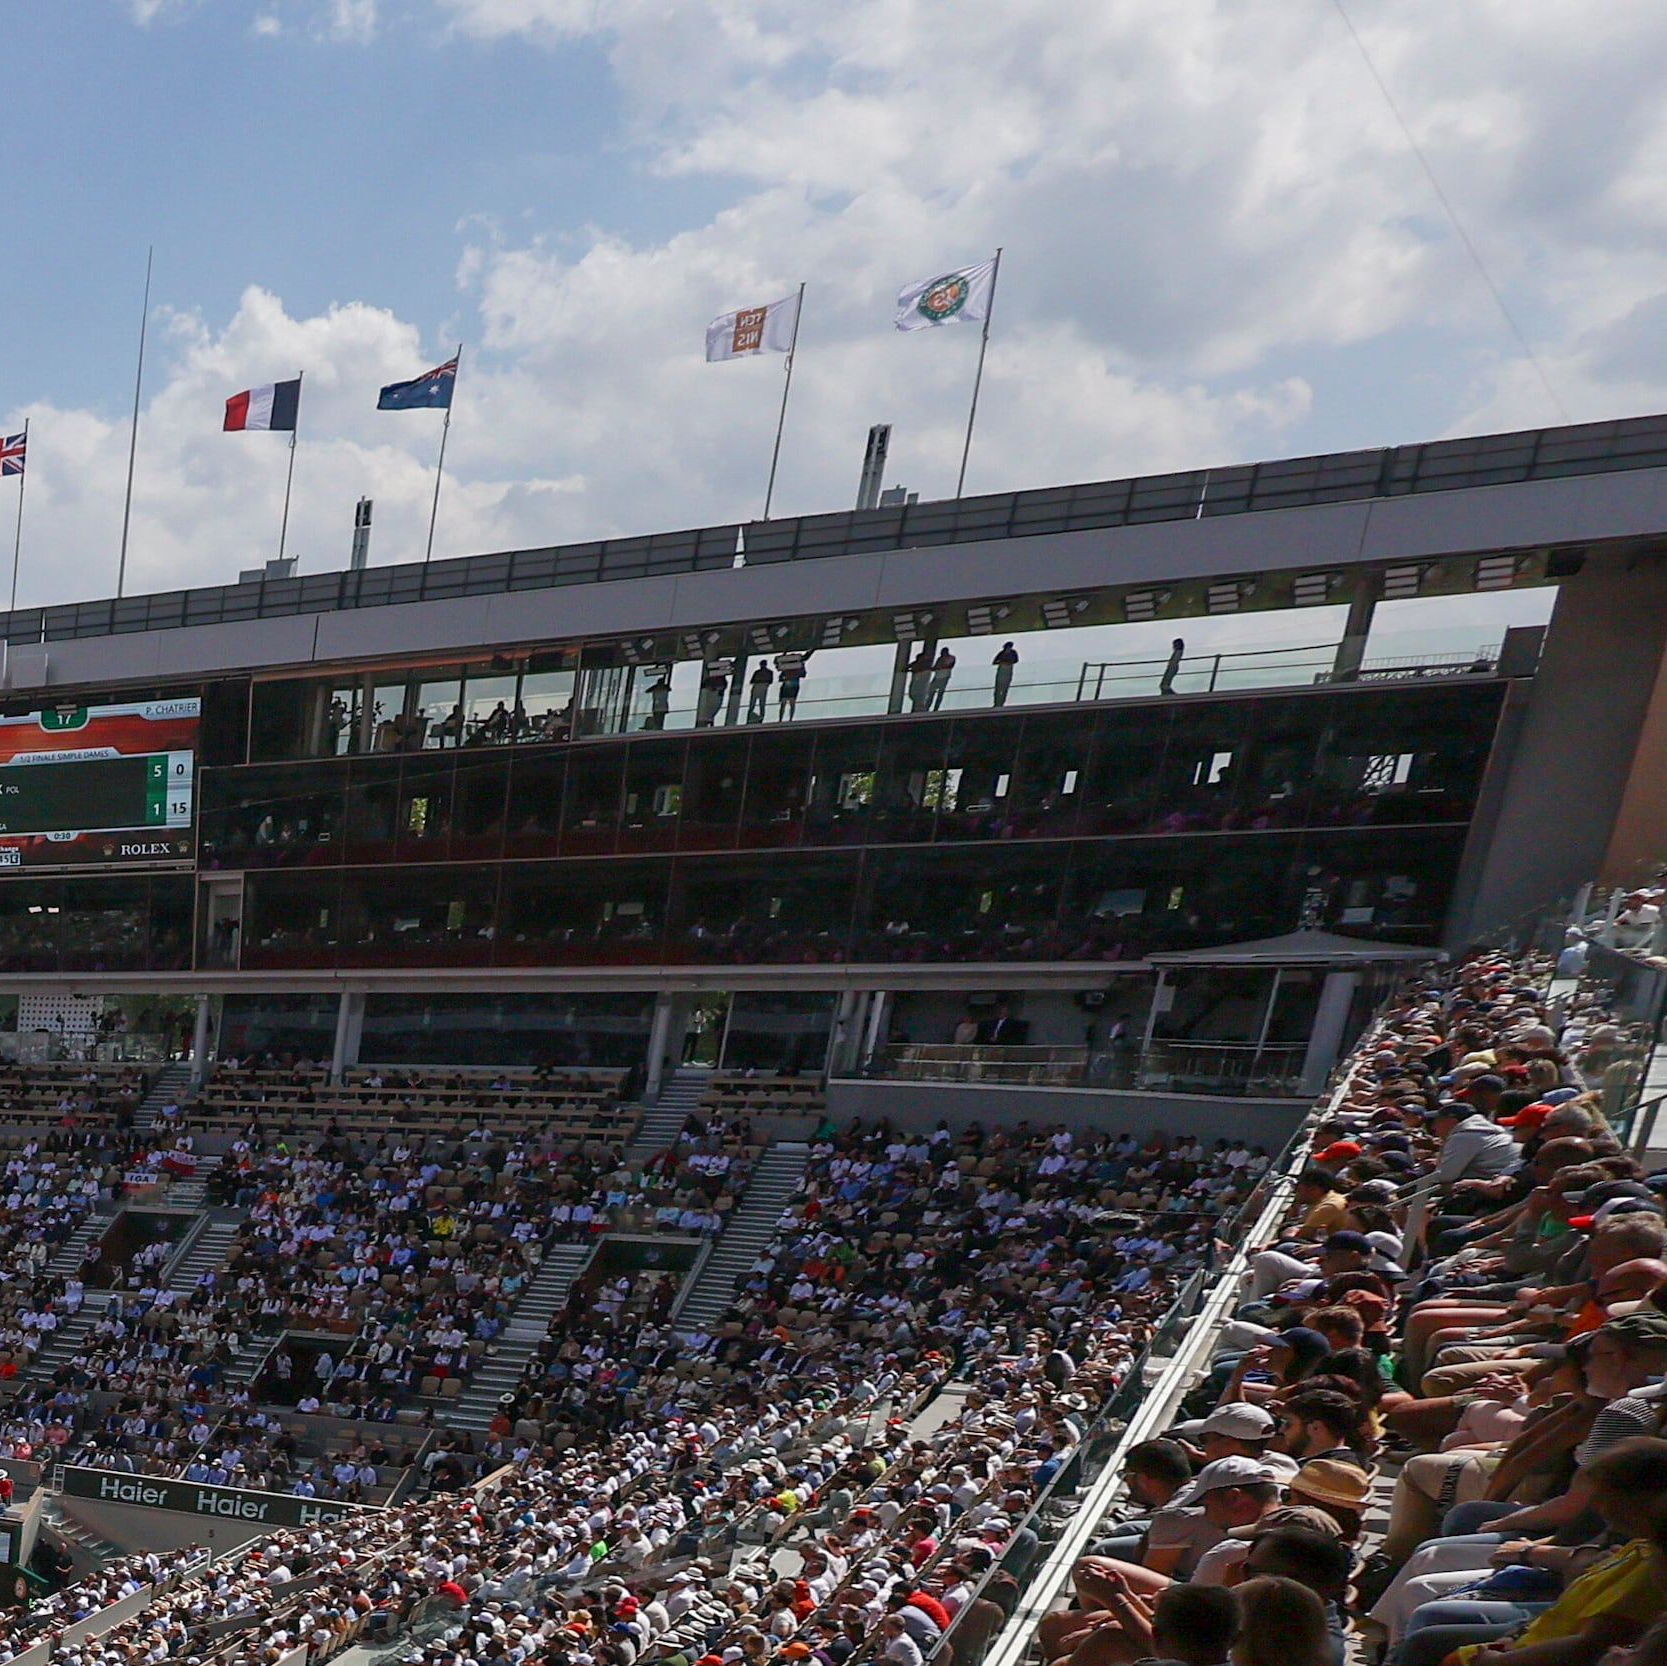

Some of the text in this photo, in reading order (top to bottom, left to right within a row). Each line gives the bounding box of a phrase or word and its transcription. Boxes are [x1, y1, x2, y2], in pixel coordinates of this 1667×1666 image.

[154, 703, 198, 714] CHATRIER
[32, 754, 56, 762] FINALE
[58, 752, 82, 760] SIMPLE
[83, 750, 109, 758] DAMES
[154, 764, 184, 777] 5 0
[6, 787, 19, 795] POL
[154, 802, 187, 815] 1 15
[54, 832, 71, 840] 0:30
[121, 843, 170, 856] ROLEX
[130, 1175, 149, 1183] IGA
[100, 1477, 168, 1505] Haier
[197, 1491, 268, 1519] Haier
